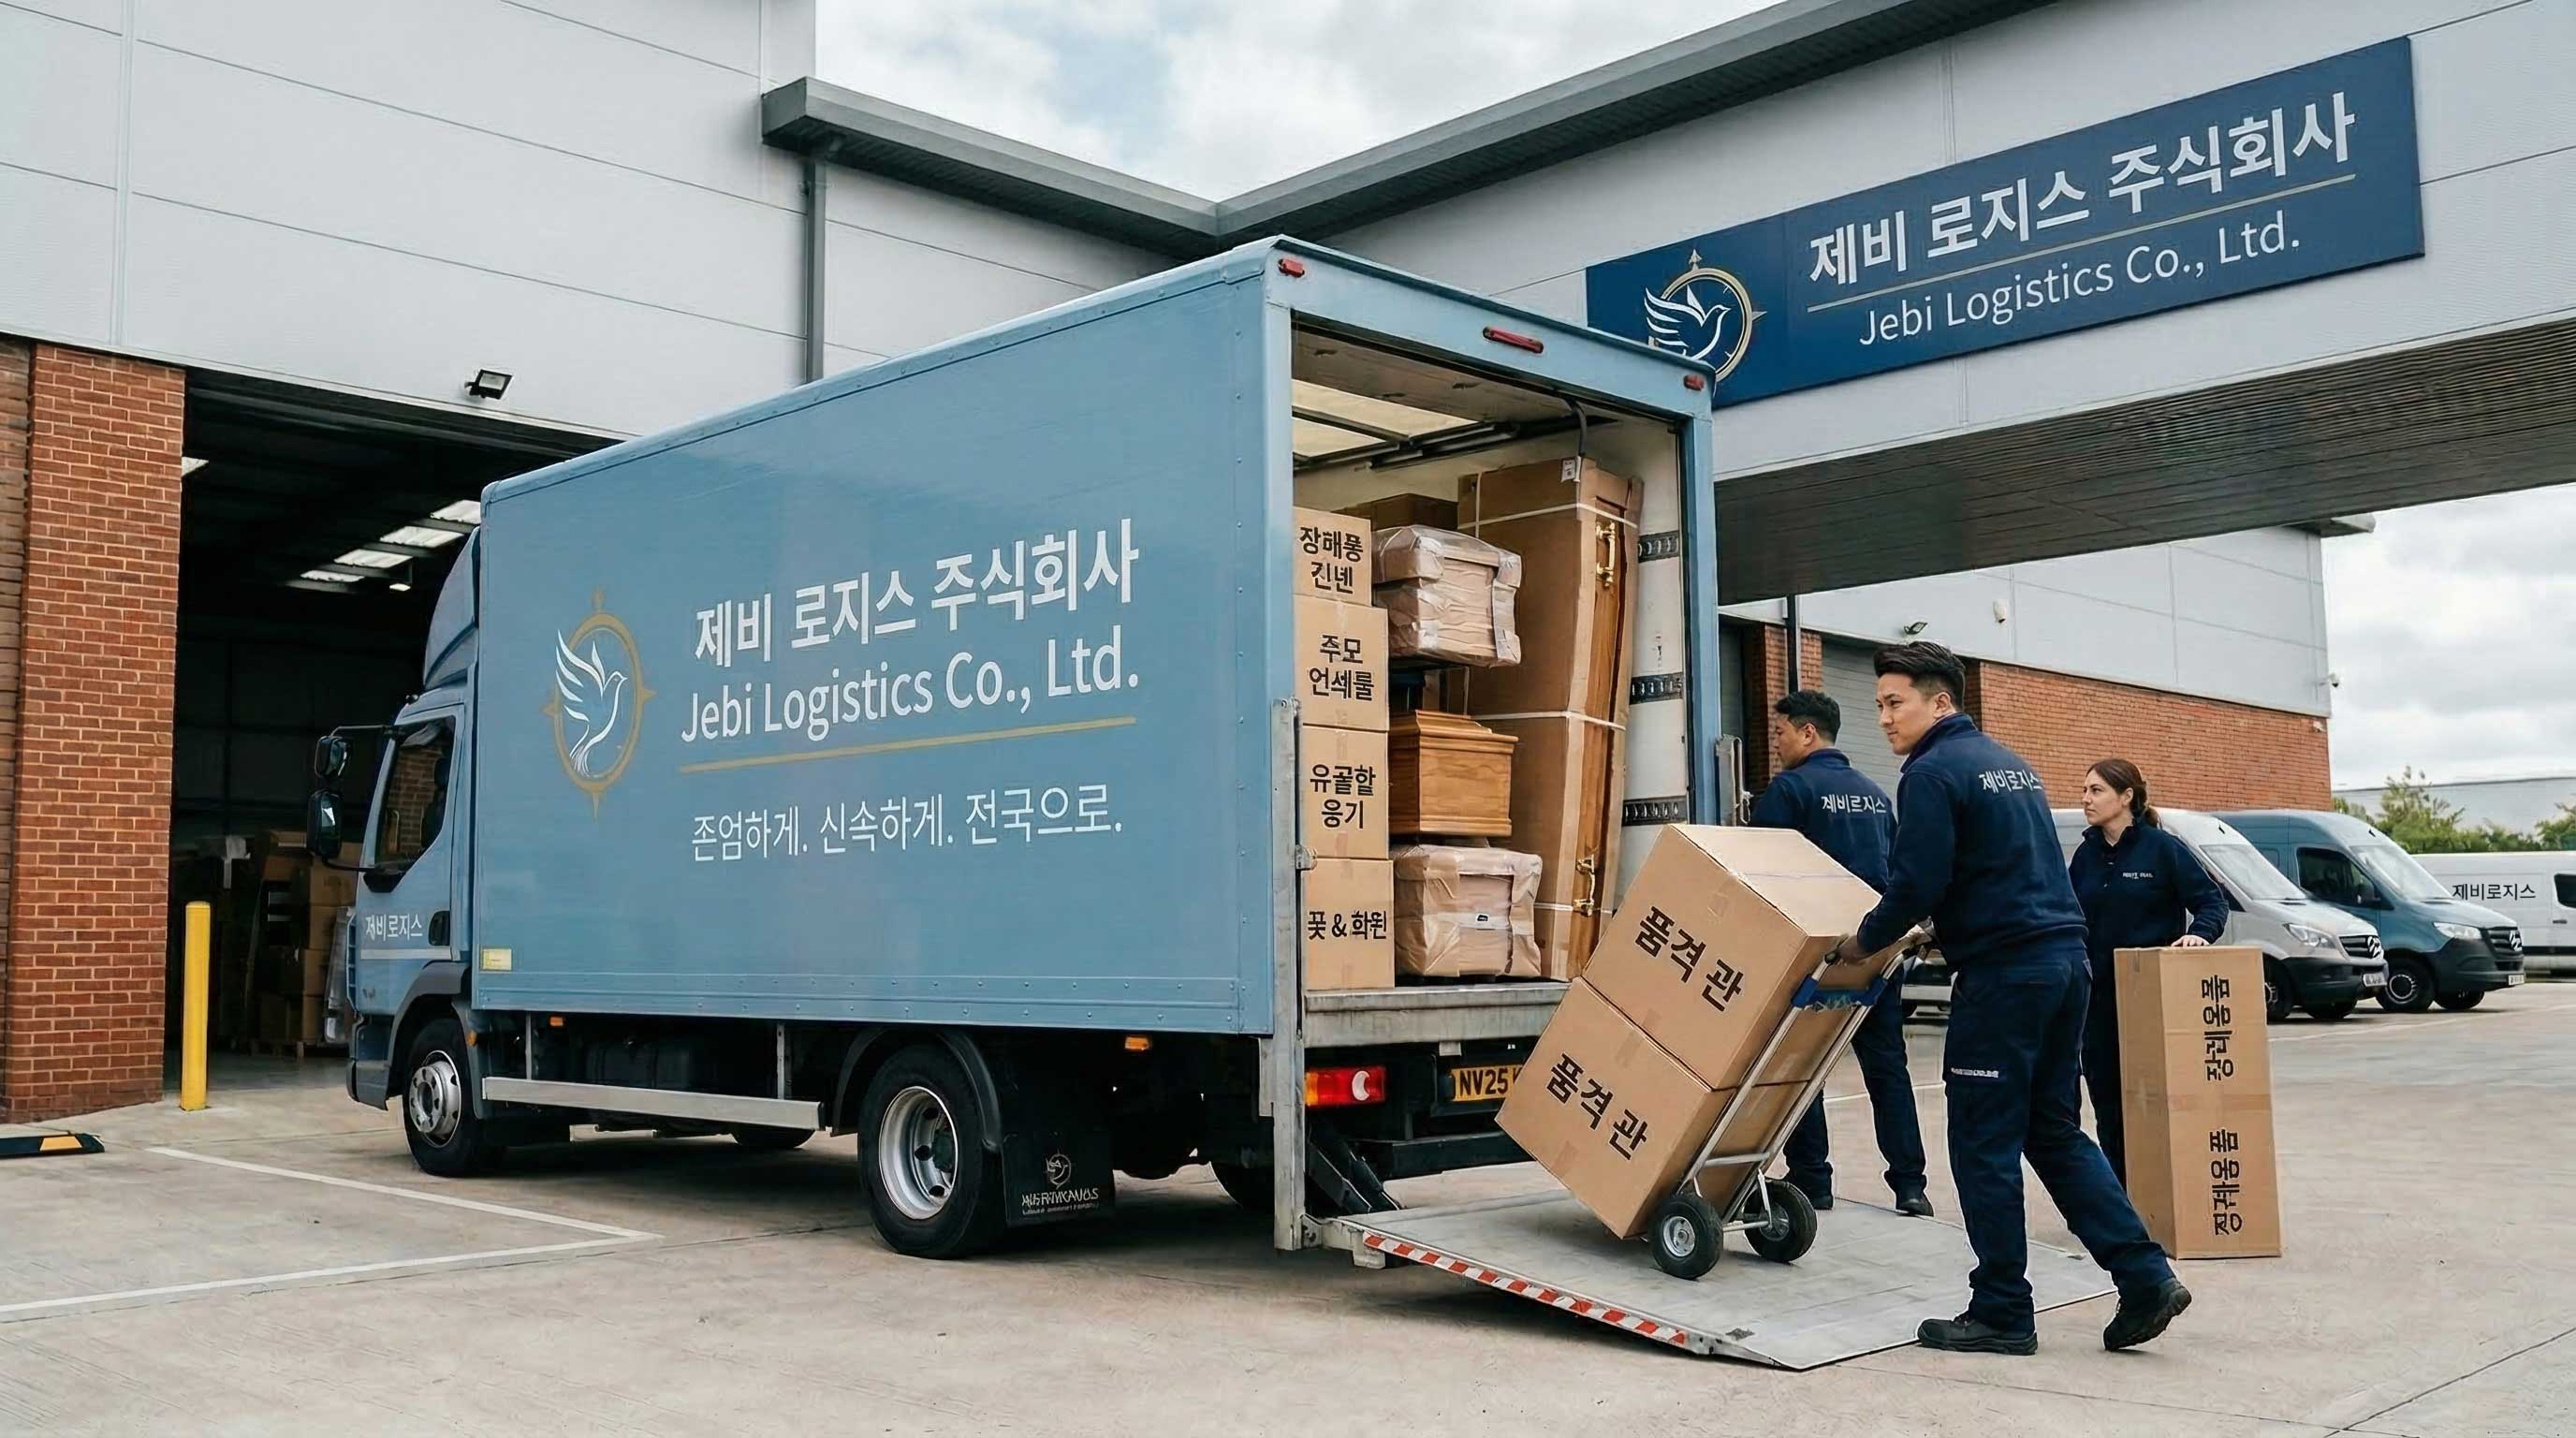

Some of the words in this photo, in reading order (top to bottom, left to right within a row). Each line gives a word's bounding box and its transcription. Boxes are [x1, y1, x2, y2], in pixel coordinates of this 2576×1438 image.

[1809, 211, 1907, 285] 제비
[1927, 171, 2090, 258] 로지스
[2108, 92, 2355, 214] 주식회사
[1859, 295, 1932, 345] Jebi
[1947, 263, 2114, 326] Logistics
[2126, 246, 2204, 283] Co.,
[2218, 211, 2300, 264] Ltd.
[695, 594, 771, 668] 제비
[791, 571, 916, 649] 로지스
[931, 519, 1139, 632] 주식회사
[681, 682, 752, 742] Jebi
[764, 662, 933, 741] Logistics
[945, 653, 1031, 713] Co.,
[1047, 625, 1138, 697] Ltd.
[692, 806, 808, 861] 존엄하게.
[819, 796, 954, 853] 신속하게.
[965, 785, 1122, 845] 전국으로.
[1331, 914, 1348, 938] &
[1634, 905, 1707, 983] 품격
[1701, 958, 1745, 1012] 관
[1545, 1052, 1614, 1130] 품격
[1608, 1108, 1648, 1161] 관
